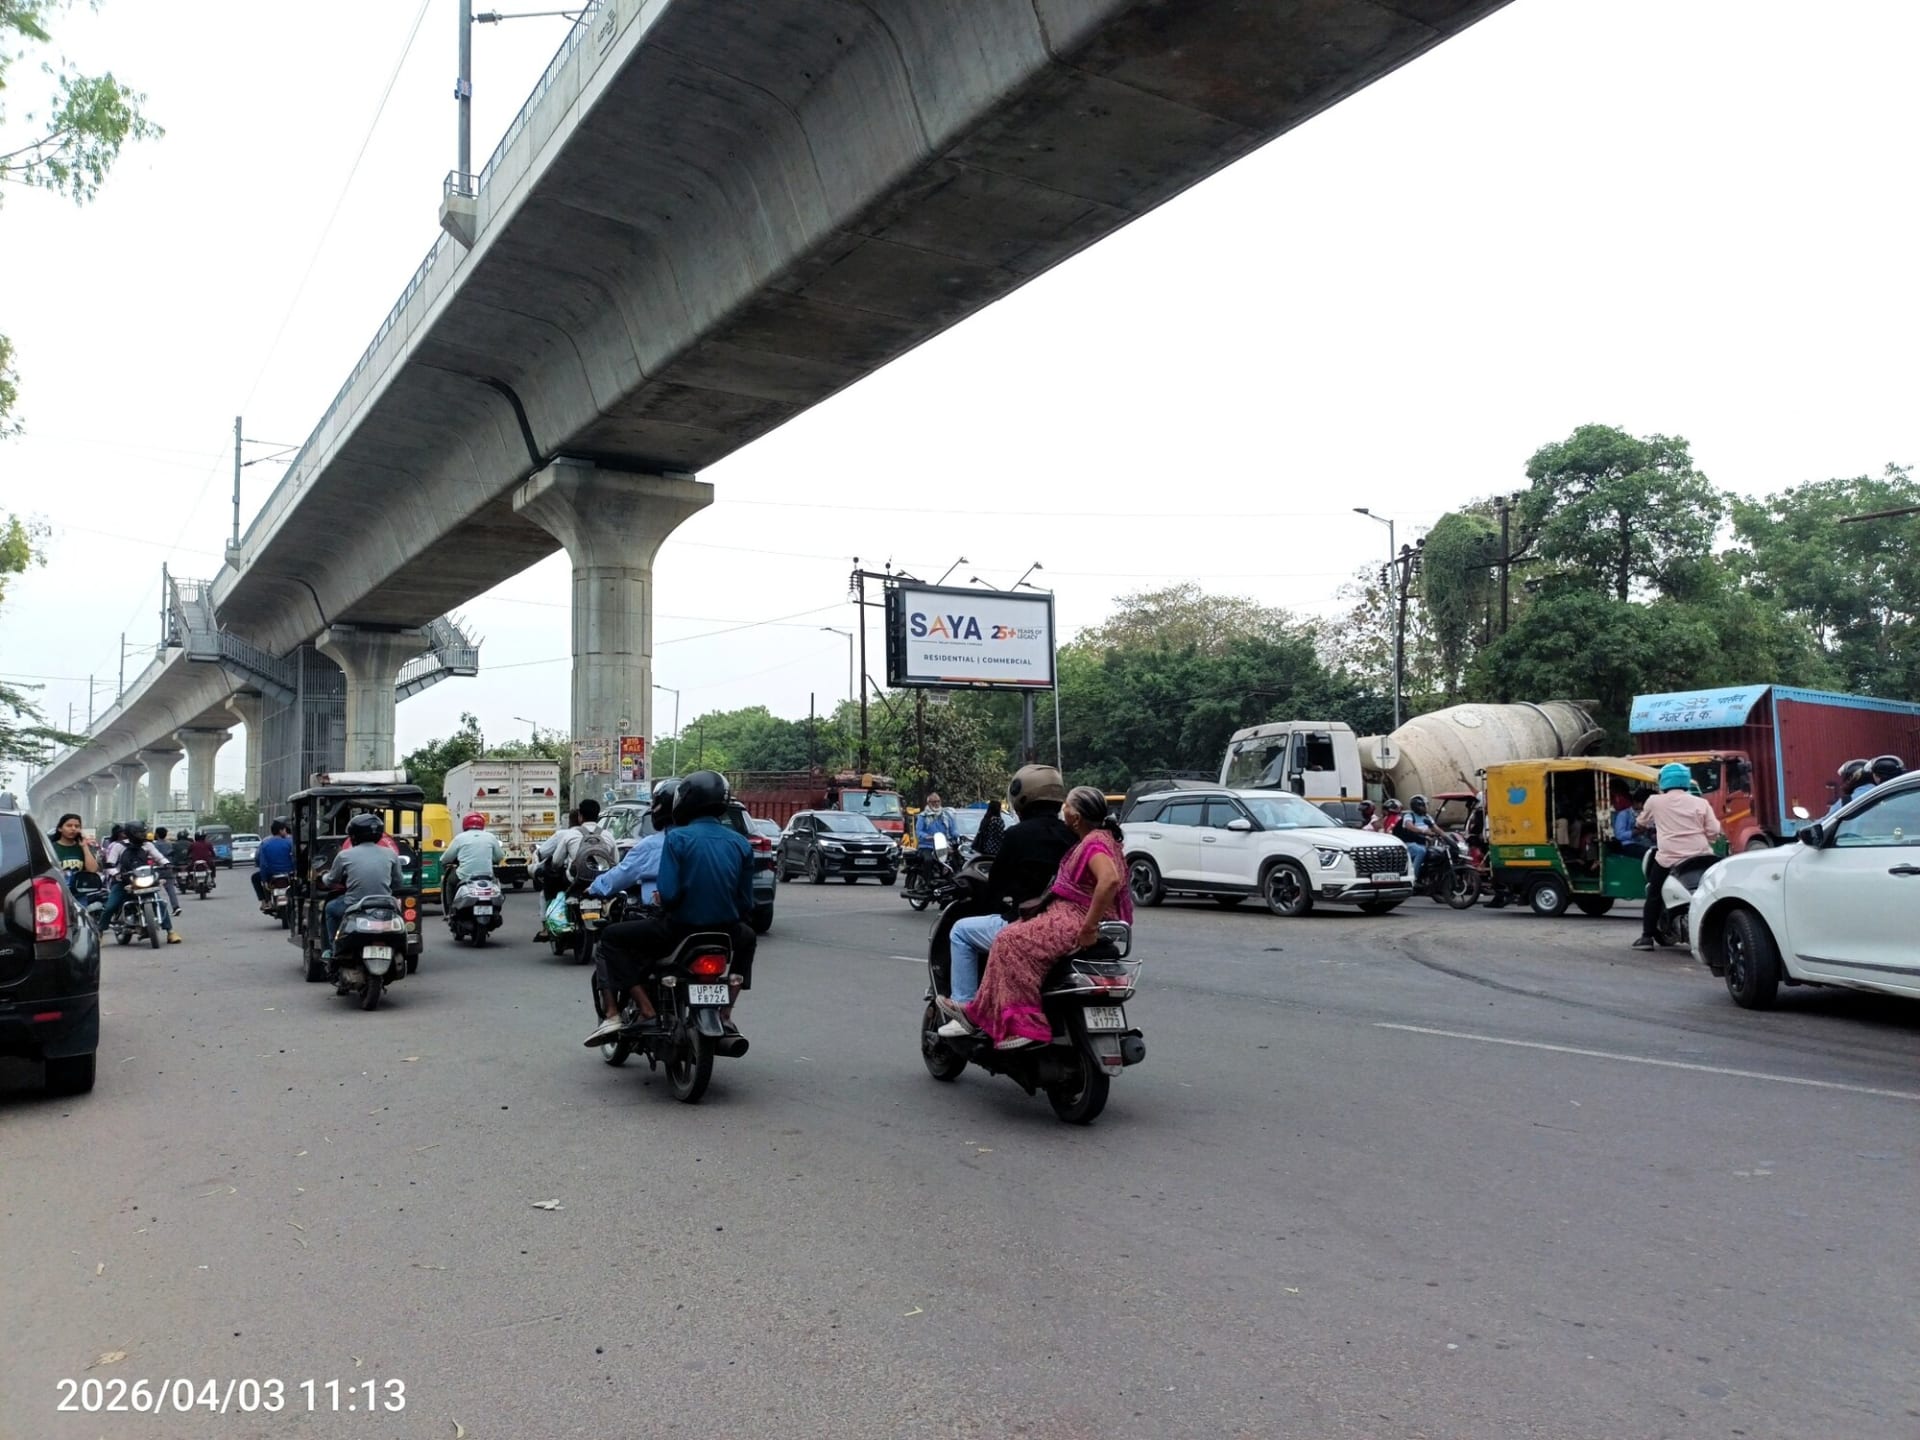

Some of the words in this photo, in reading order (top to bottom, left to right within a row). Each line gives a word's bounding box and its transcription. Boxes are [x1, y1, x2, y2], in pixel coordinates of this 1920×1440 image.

[910, 612, 982, 641] SAYA
[991, 625, 1017, 641] 25+
[924, 654, 975, 663] RESIDENTIAL
[982, 656, 1032, 665] COMMERCIAL
